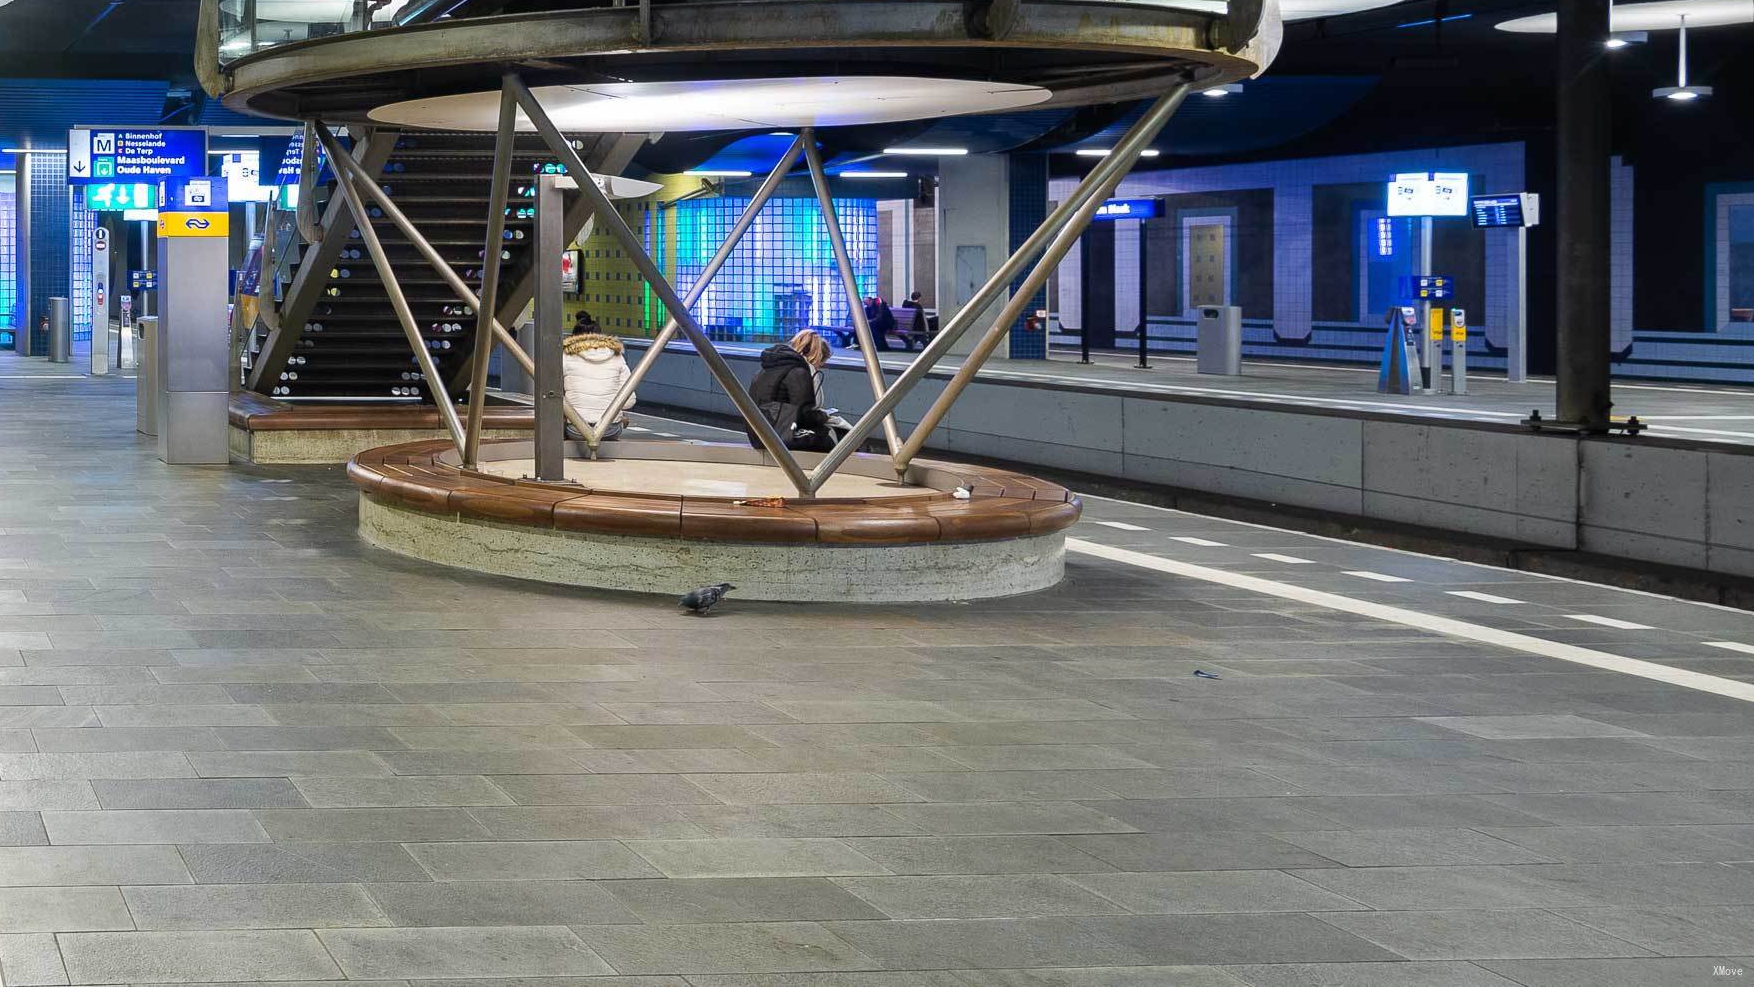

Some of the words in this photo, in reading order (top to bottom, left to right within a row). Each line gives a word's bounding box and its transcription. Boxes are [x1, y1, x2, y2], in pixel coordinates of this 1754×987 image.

[97, 139, 111, 152] M
[117, 156, 185, 164] Maasboulevard
[117, 166, 141, 174] Oude
[142, 166, 172, 174] Haven
